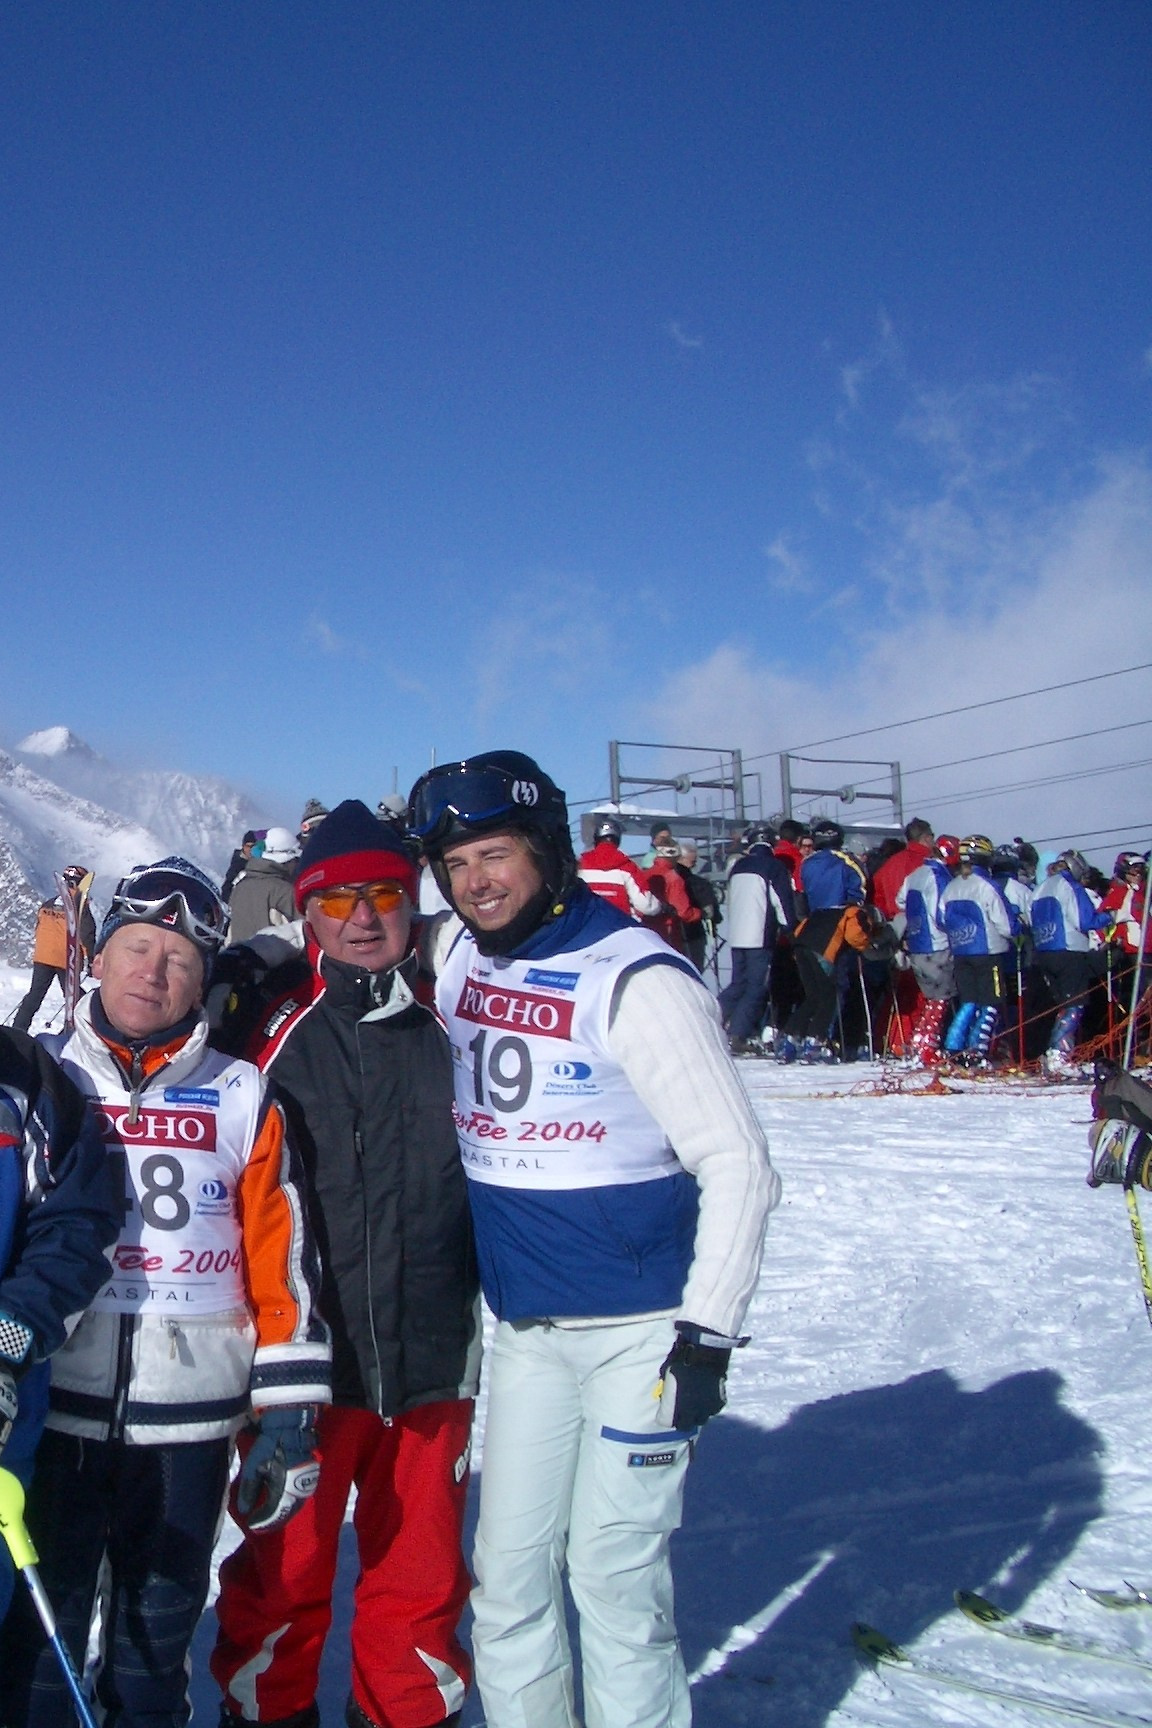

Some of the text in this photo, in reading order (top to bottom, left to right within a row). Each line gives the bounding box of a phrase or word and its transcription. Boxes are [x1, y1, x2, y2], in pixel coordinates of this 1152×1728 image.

[469, 1029, 533, 1113] 19
[517, 1120, 608, 1143] 2004
[172, 1249, 241, 1274] 2004
